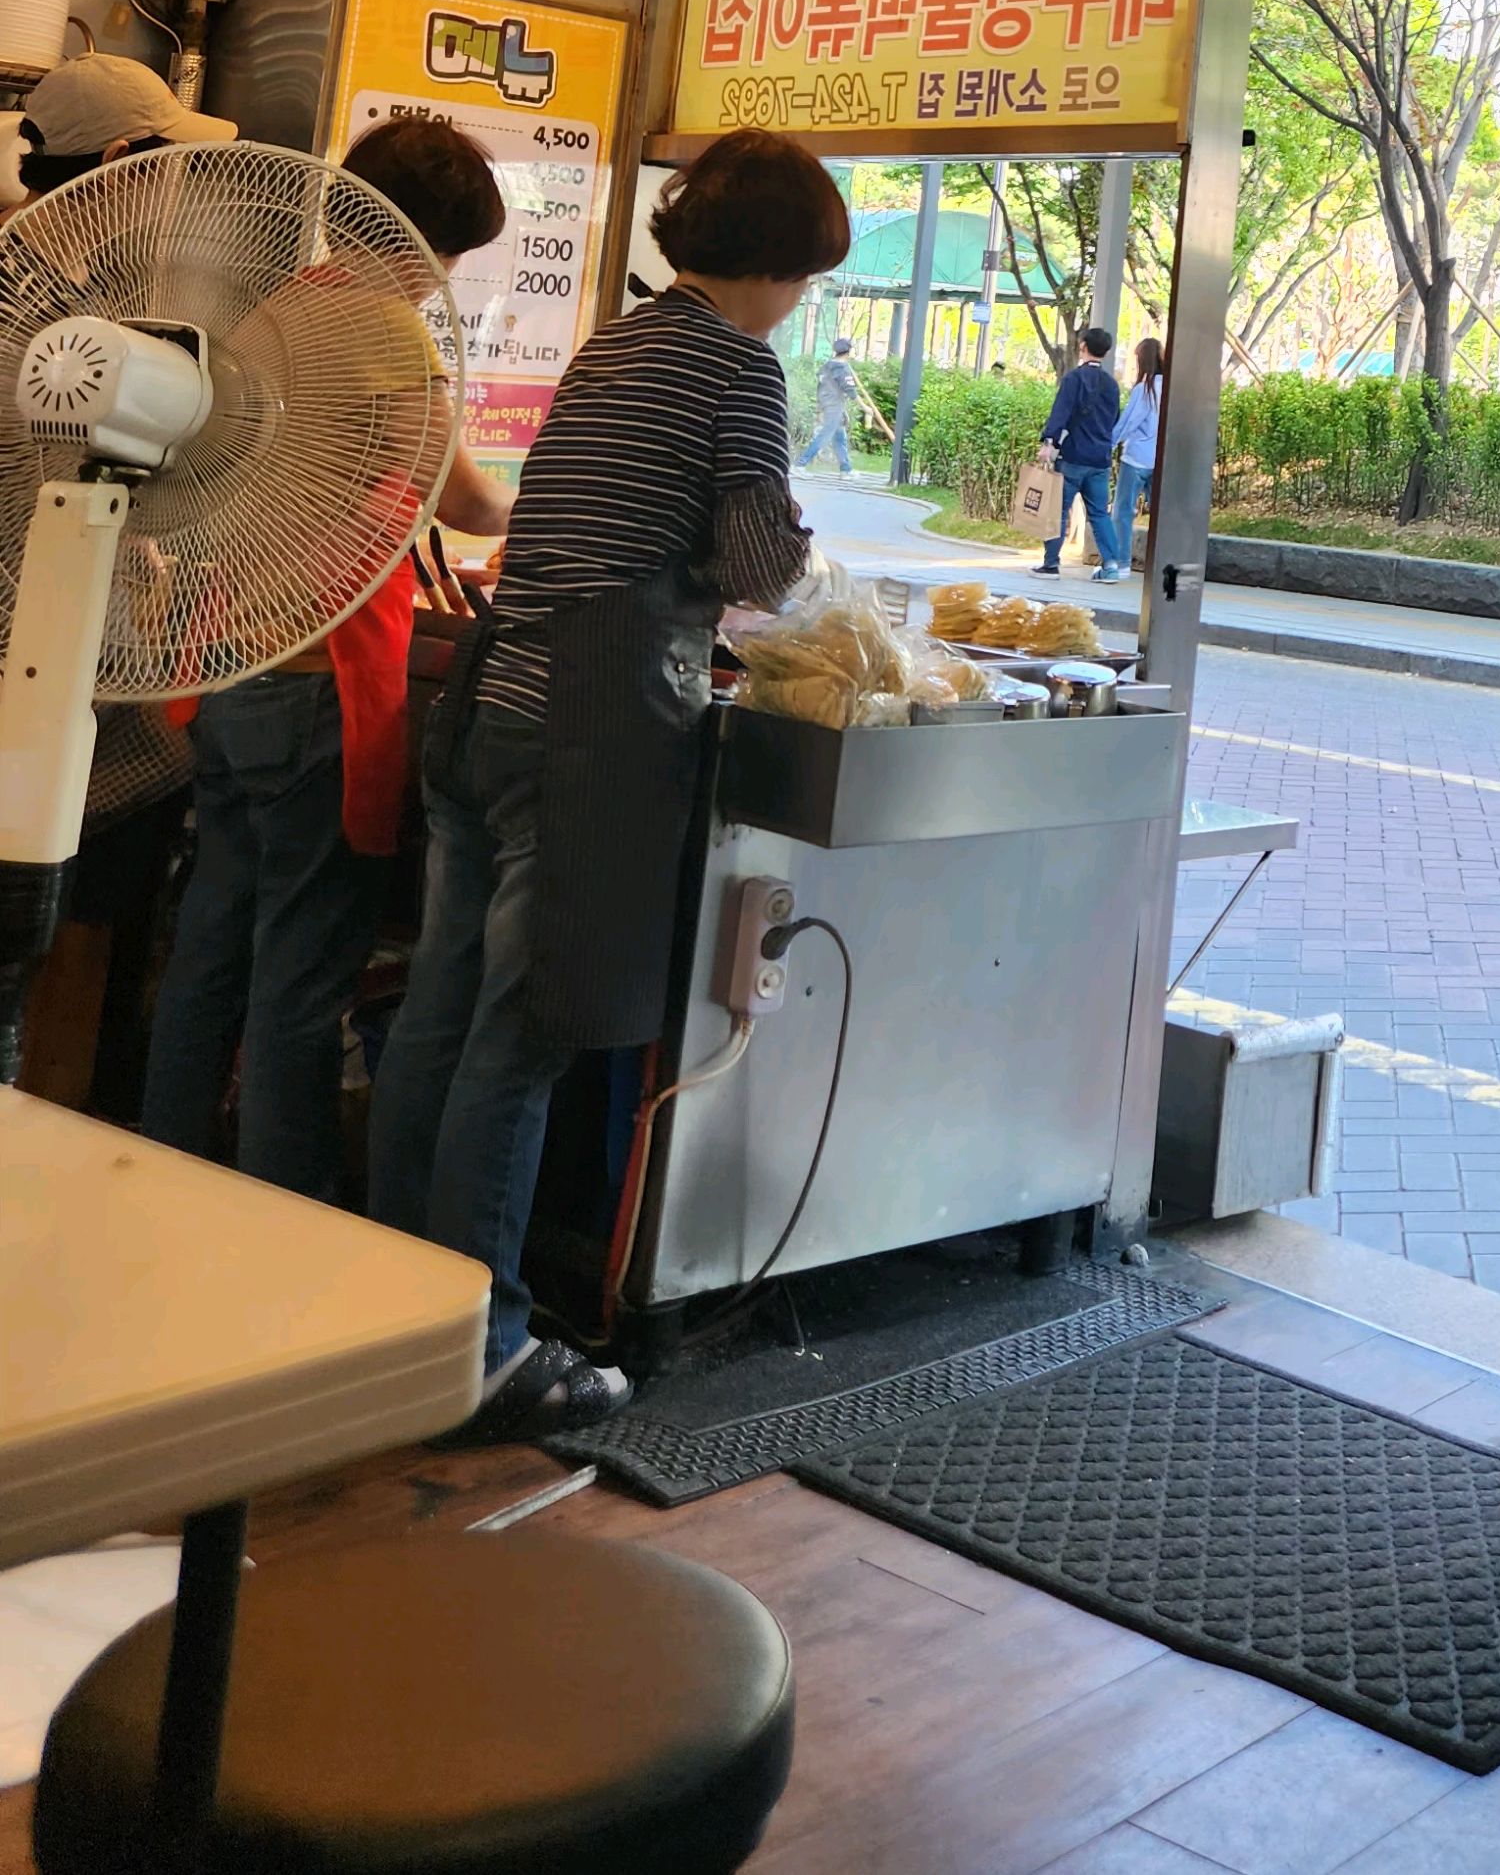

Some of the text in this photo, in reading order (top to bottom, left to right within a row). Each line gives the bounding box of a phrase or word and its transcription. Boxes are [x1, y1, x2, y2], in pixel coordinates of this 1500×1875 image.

[426, 11, 555, 104] 메뉴
[533, 126, 590, 150] 4,500
[521, 236, 573, 261] 1500
[515, 270, 571, 297] 2000
